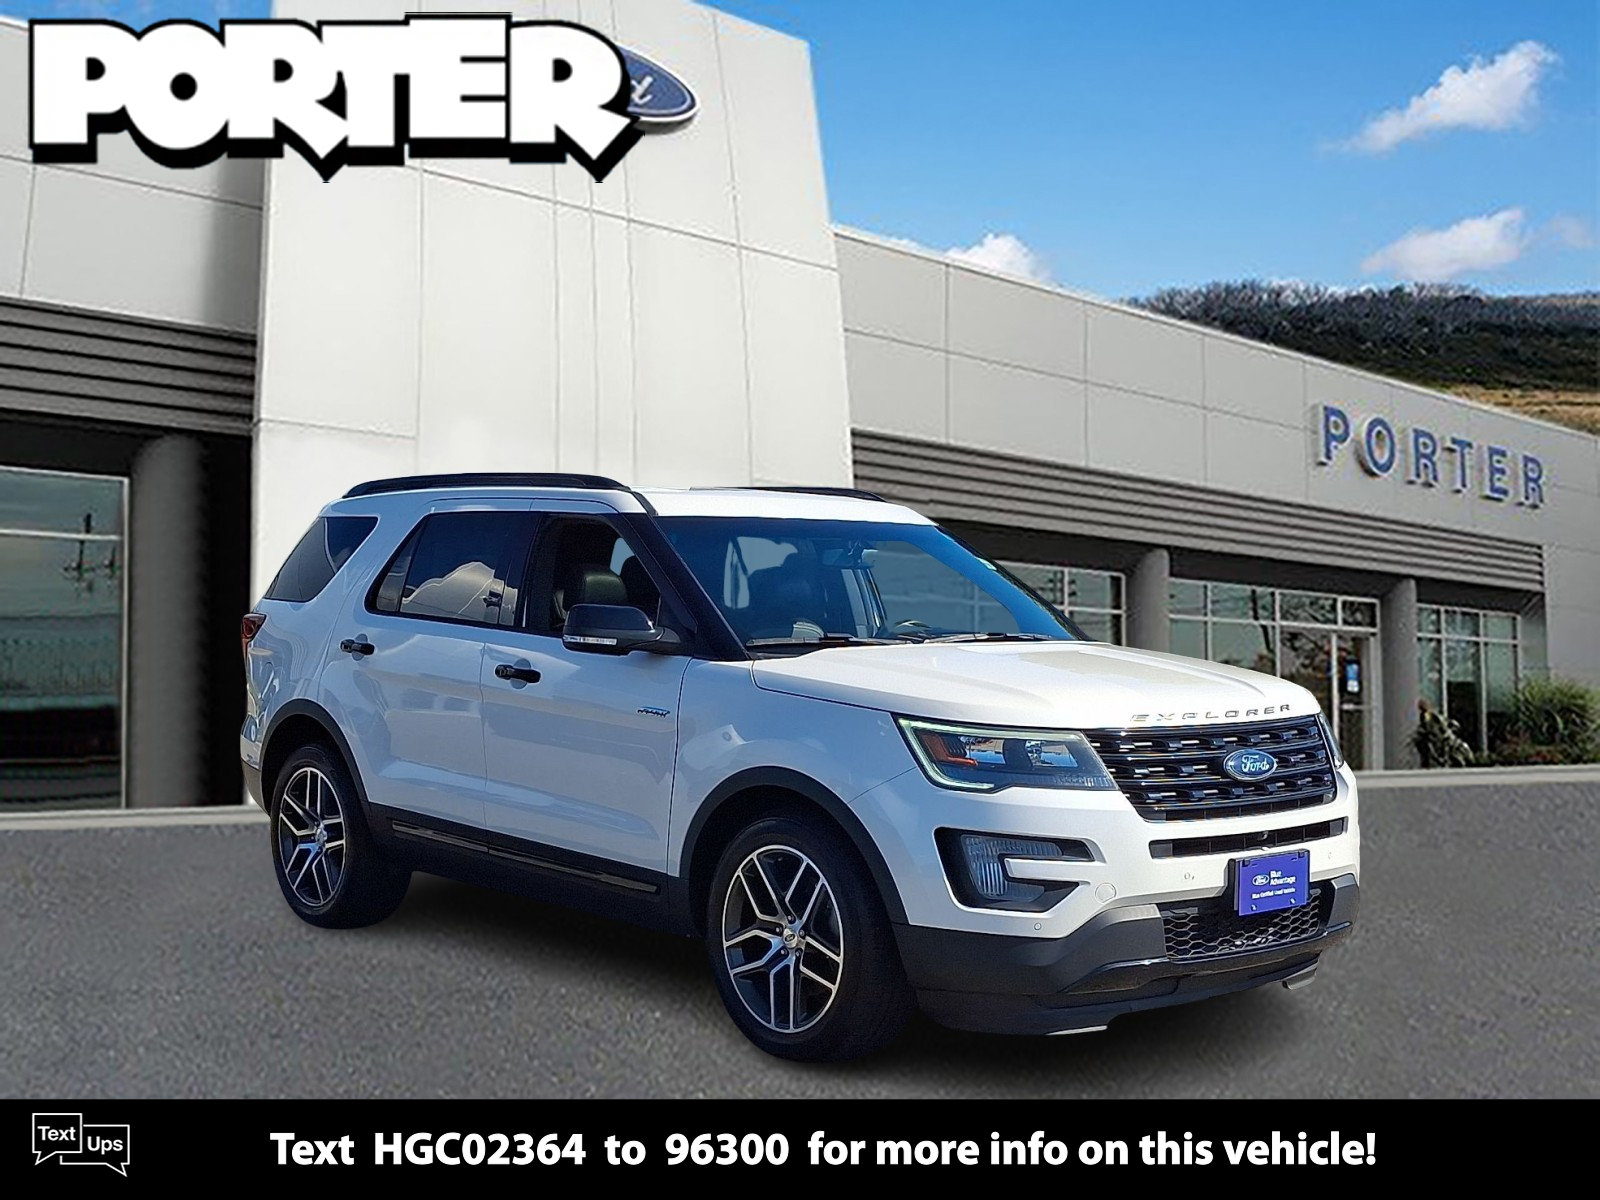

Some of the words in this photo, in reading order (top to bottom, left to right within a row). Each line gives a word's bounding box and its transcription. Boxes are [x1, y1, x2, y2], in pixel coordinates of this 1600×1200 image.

[1320, 404, 1544, 507] PORTER
[1130, 703, 1291, 722] EXPLORER
[1240, 753, 1270, 773] Ford
